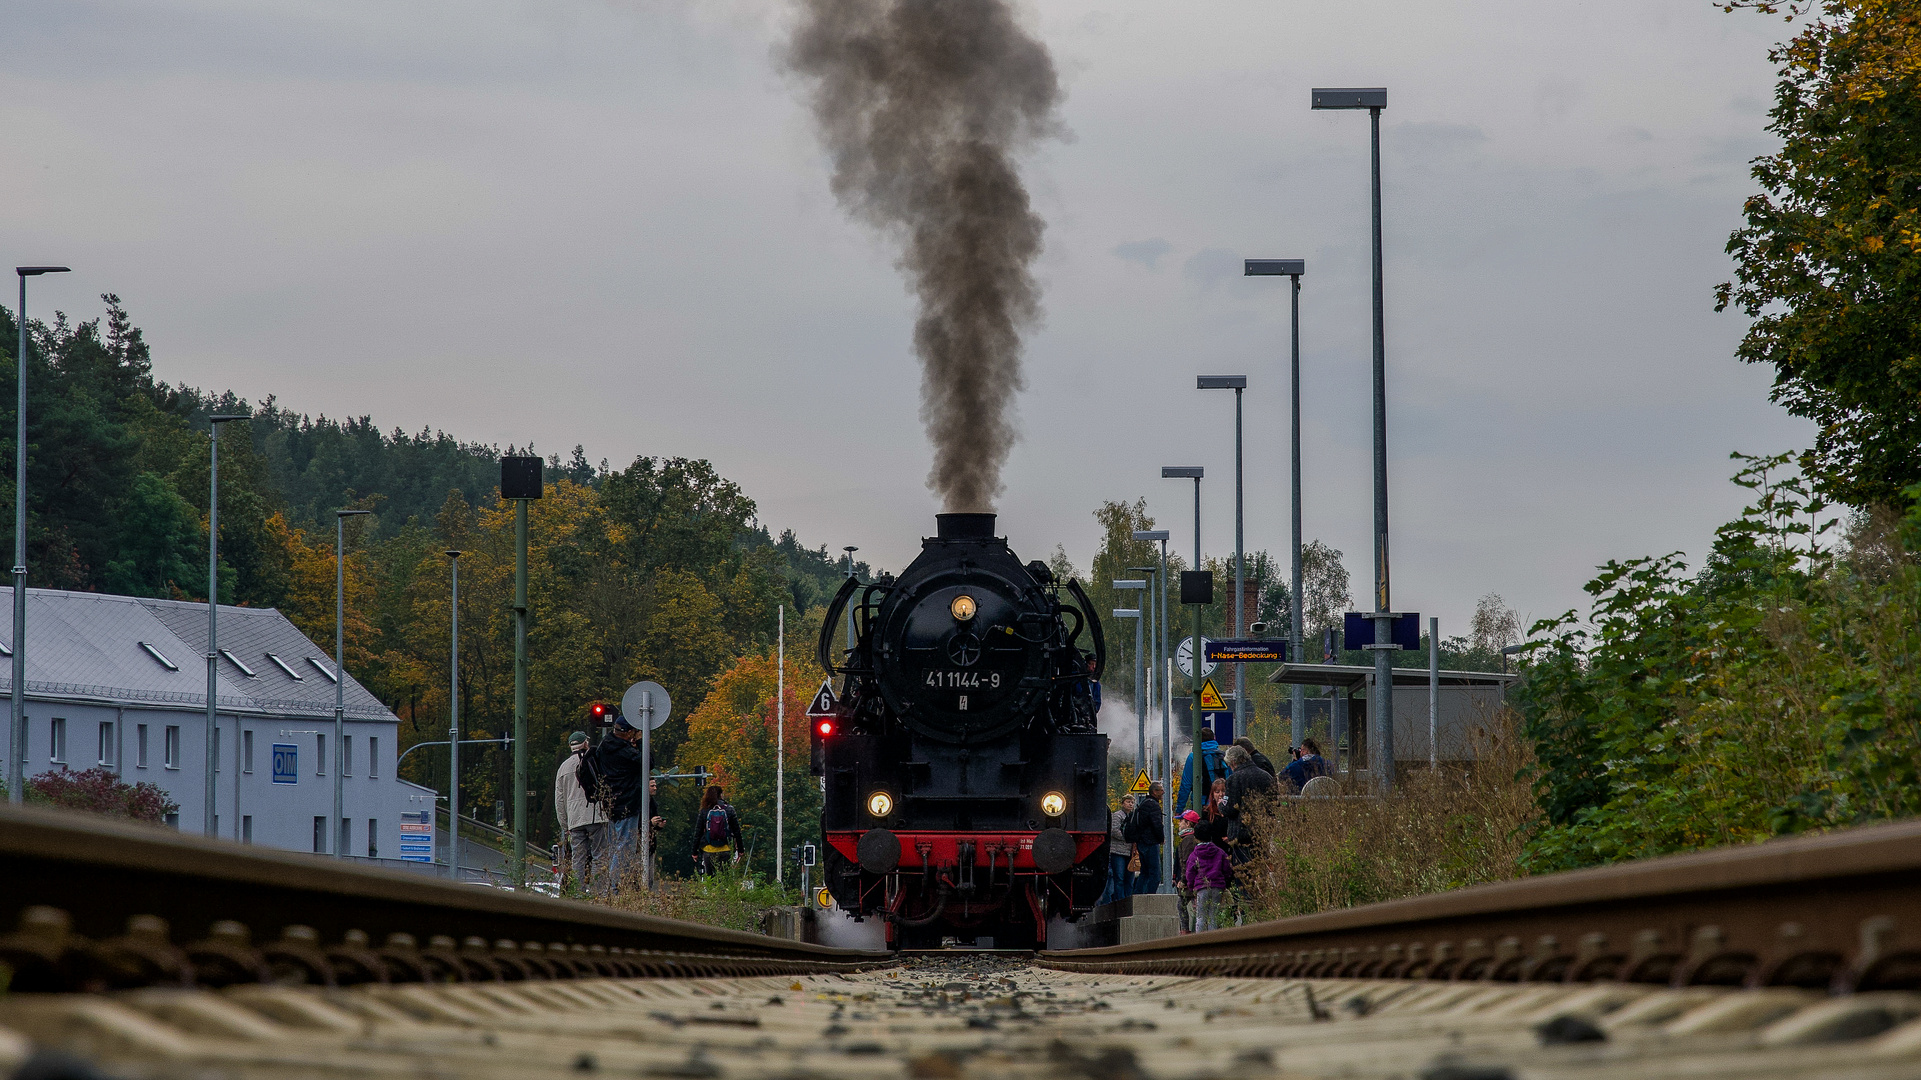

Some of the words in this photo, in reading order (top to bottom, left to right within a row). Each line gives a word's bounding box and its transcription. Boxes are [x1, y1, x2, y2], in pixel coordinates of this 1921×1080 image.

[926, 671, 943, 687] 41
[947, 672, 1000, 688] 1144-9
[820, 692, 831, 711] 6
[1204, 712, 1216, 735] 1
